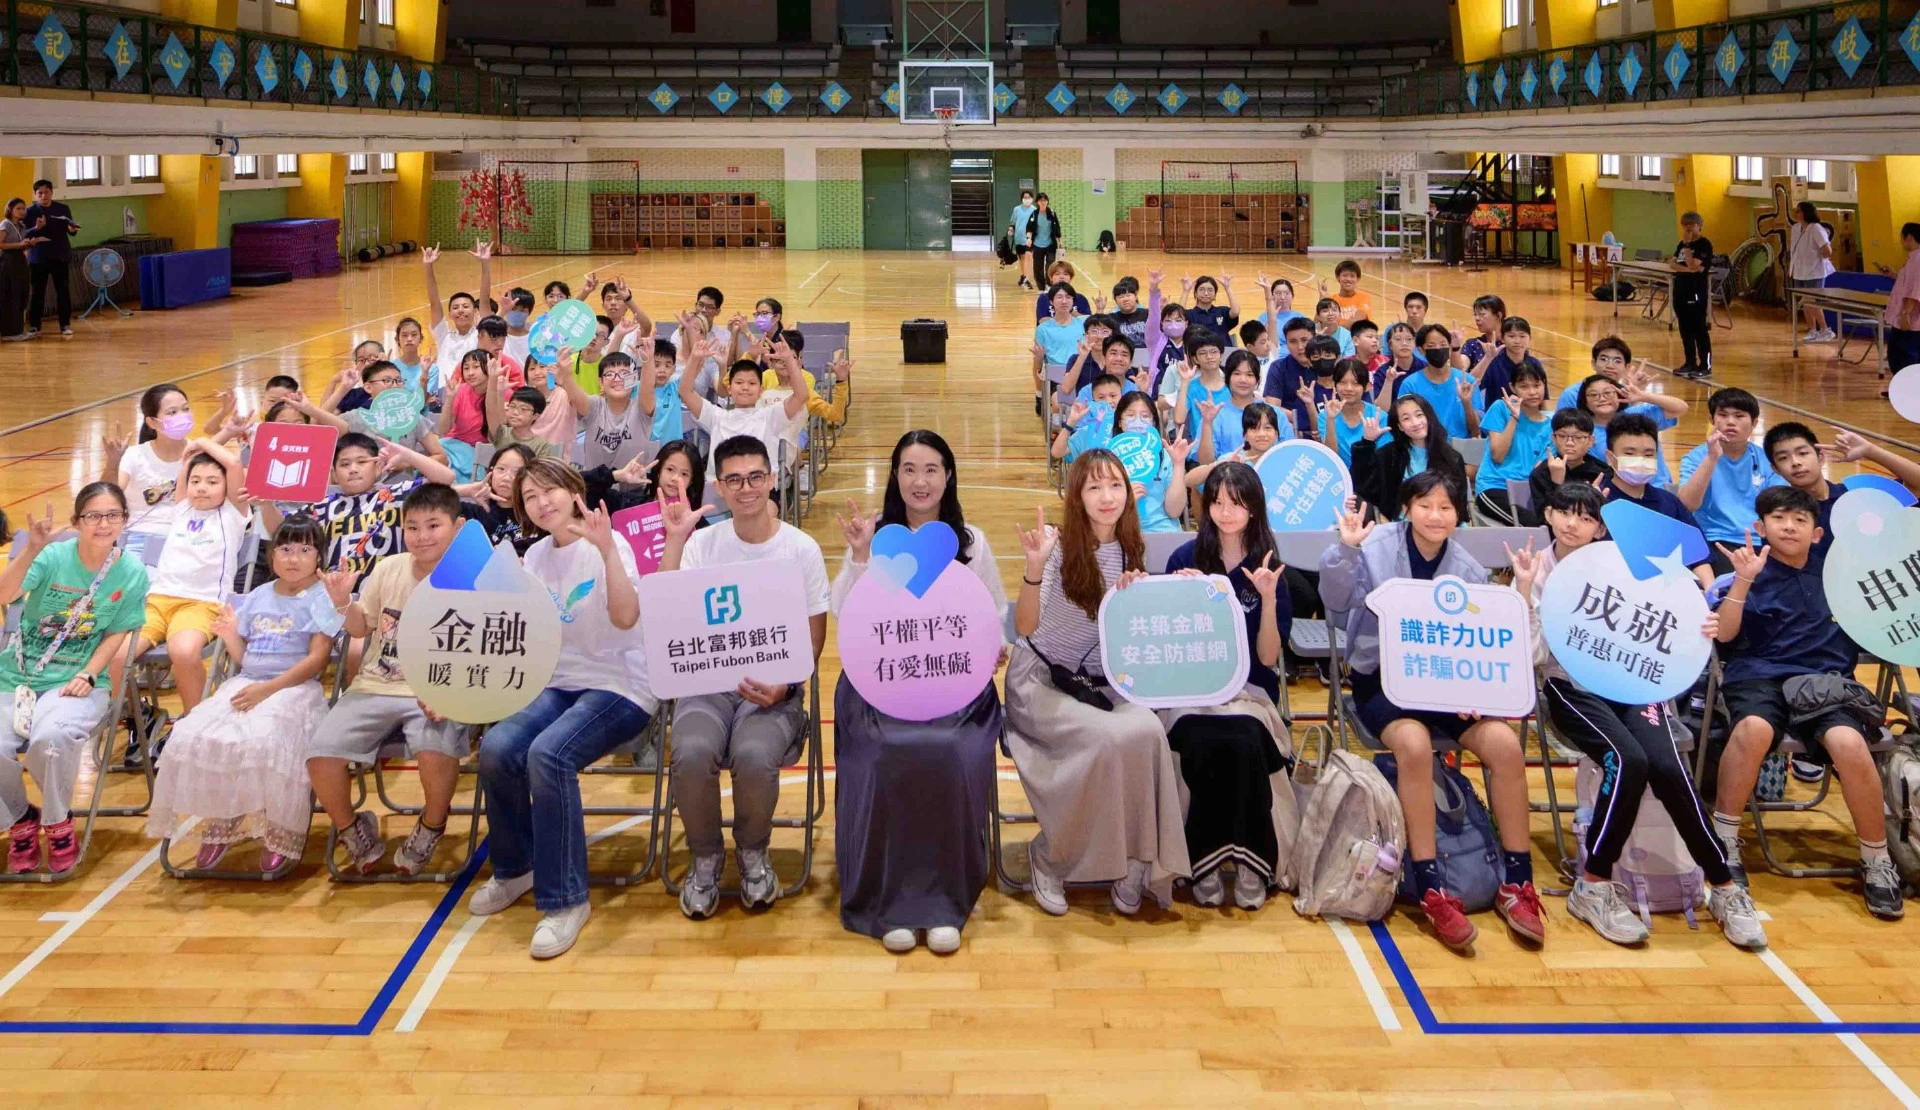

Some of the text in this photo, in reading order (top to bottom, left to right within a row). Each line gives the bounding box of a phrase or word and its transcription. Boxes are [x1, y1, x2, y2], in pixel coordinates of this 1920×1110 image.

[1610, 252, 1619, 262] A
[268, 436, 279, 451] 4
[626, 520, 640, 536] 10
[428, 608, 528, 656] 金融
[870, 614, 968, 645] 平權平等
[1129, 613, 1215, 637] 共築金融
[1400, 618, 1514, 648] 識詐力UP
[1570, 582, 1678, 655] 成就
[667, 625, 788, 658] 台北富邦銀行
[1121, 640, 1229, 665] 安全防護網
[1565, 624, 1666, 685] 普惠可能
[671, 648, 790, 674] Taipei Fubon Bank
[873, 651, 973, 683] 有愛無礙
[1403, 652, 1511, 683] 詐騙OUT
[428, 663, 525, 690] 暖實力
